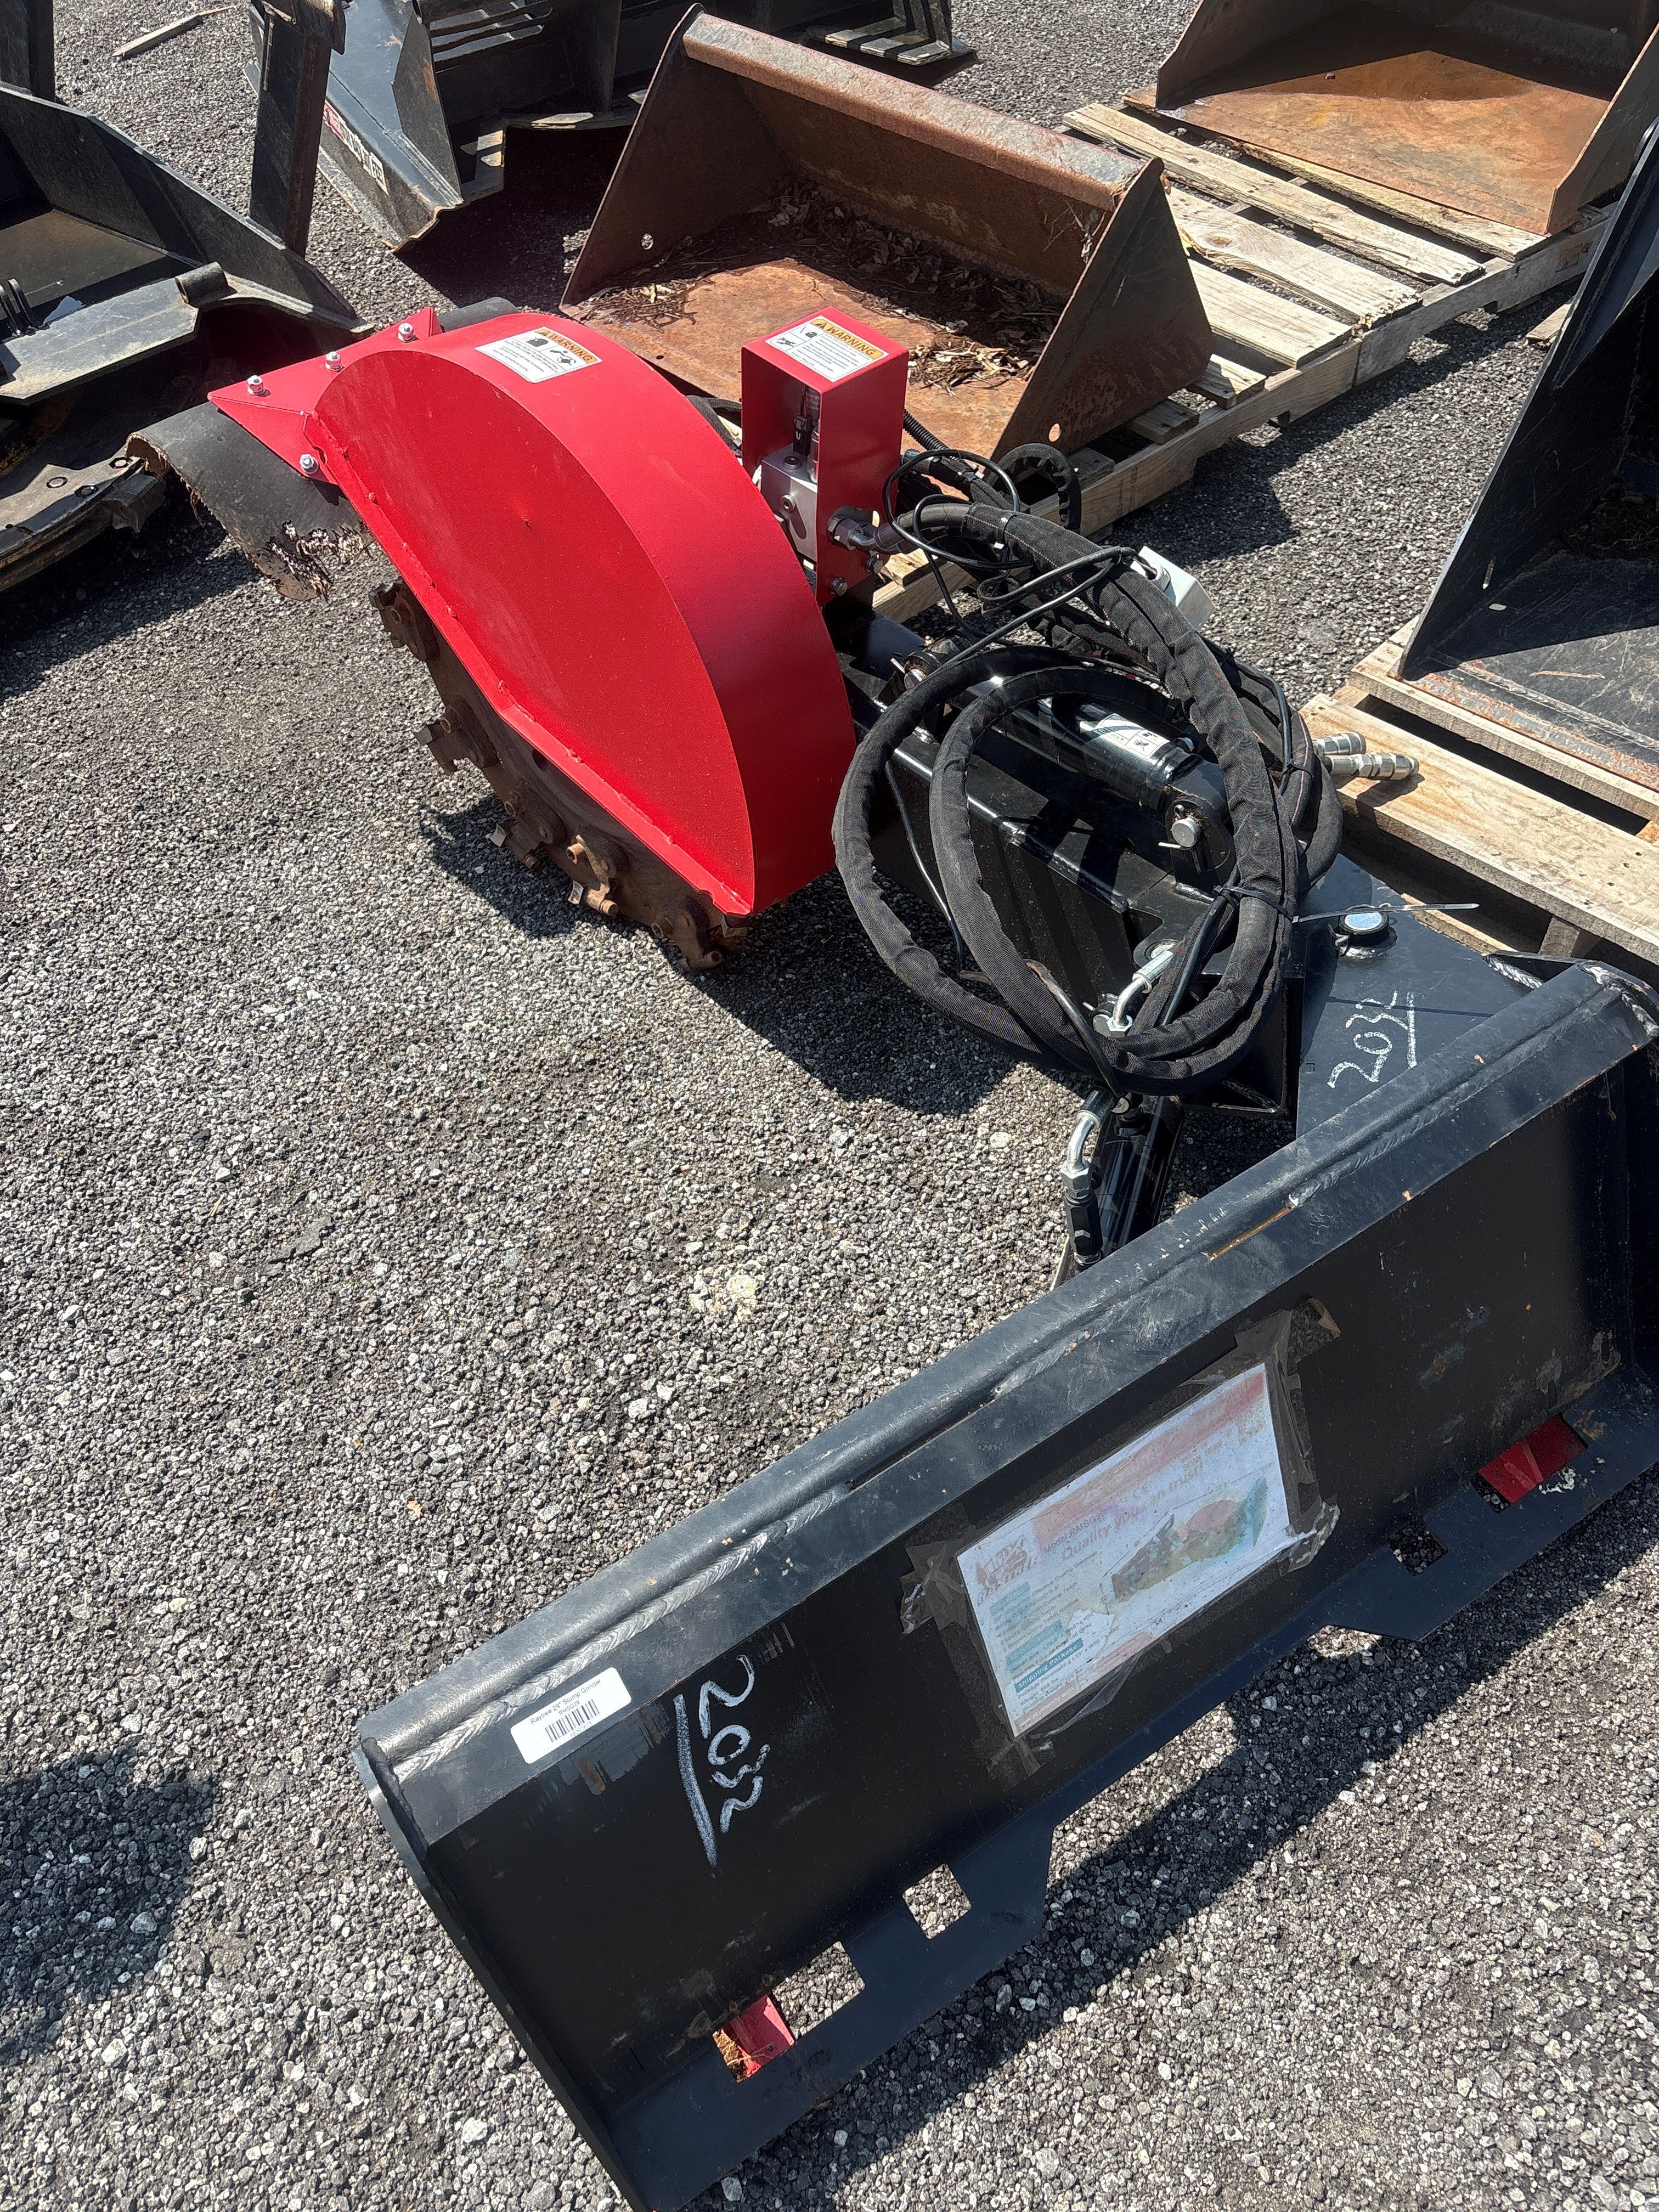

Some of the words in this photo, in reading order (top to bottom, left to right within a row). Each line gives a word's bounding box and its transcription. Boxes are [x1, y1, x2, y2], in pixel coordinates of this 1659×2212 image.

[549, 332, 593, 361] WARNING
[826, 325, 876, 356] WARNING
[1060, 1518, 1113, 1565] Quality
[1143, 1488, 1165, 1509] can
[1018, 1663, 1048, 1690] Shipping
[1018, 1680, 1040, 1701] Package
[529, 1708, 552, 1725] Raytree
[562, 1691, 581, 1706] Stump
[580, 1678, 601, 1694] Grinder
[558, 1700, 580, 1716] RMSG29
[699, 1654, 770, 1833] 2032
